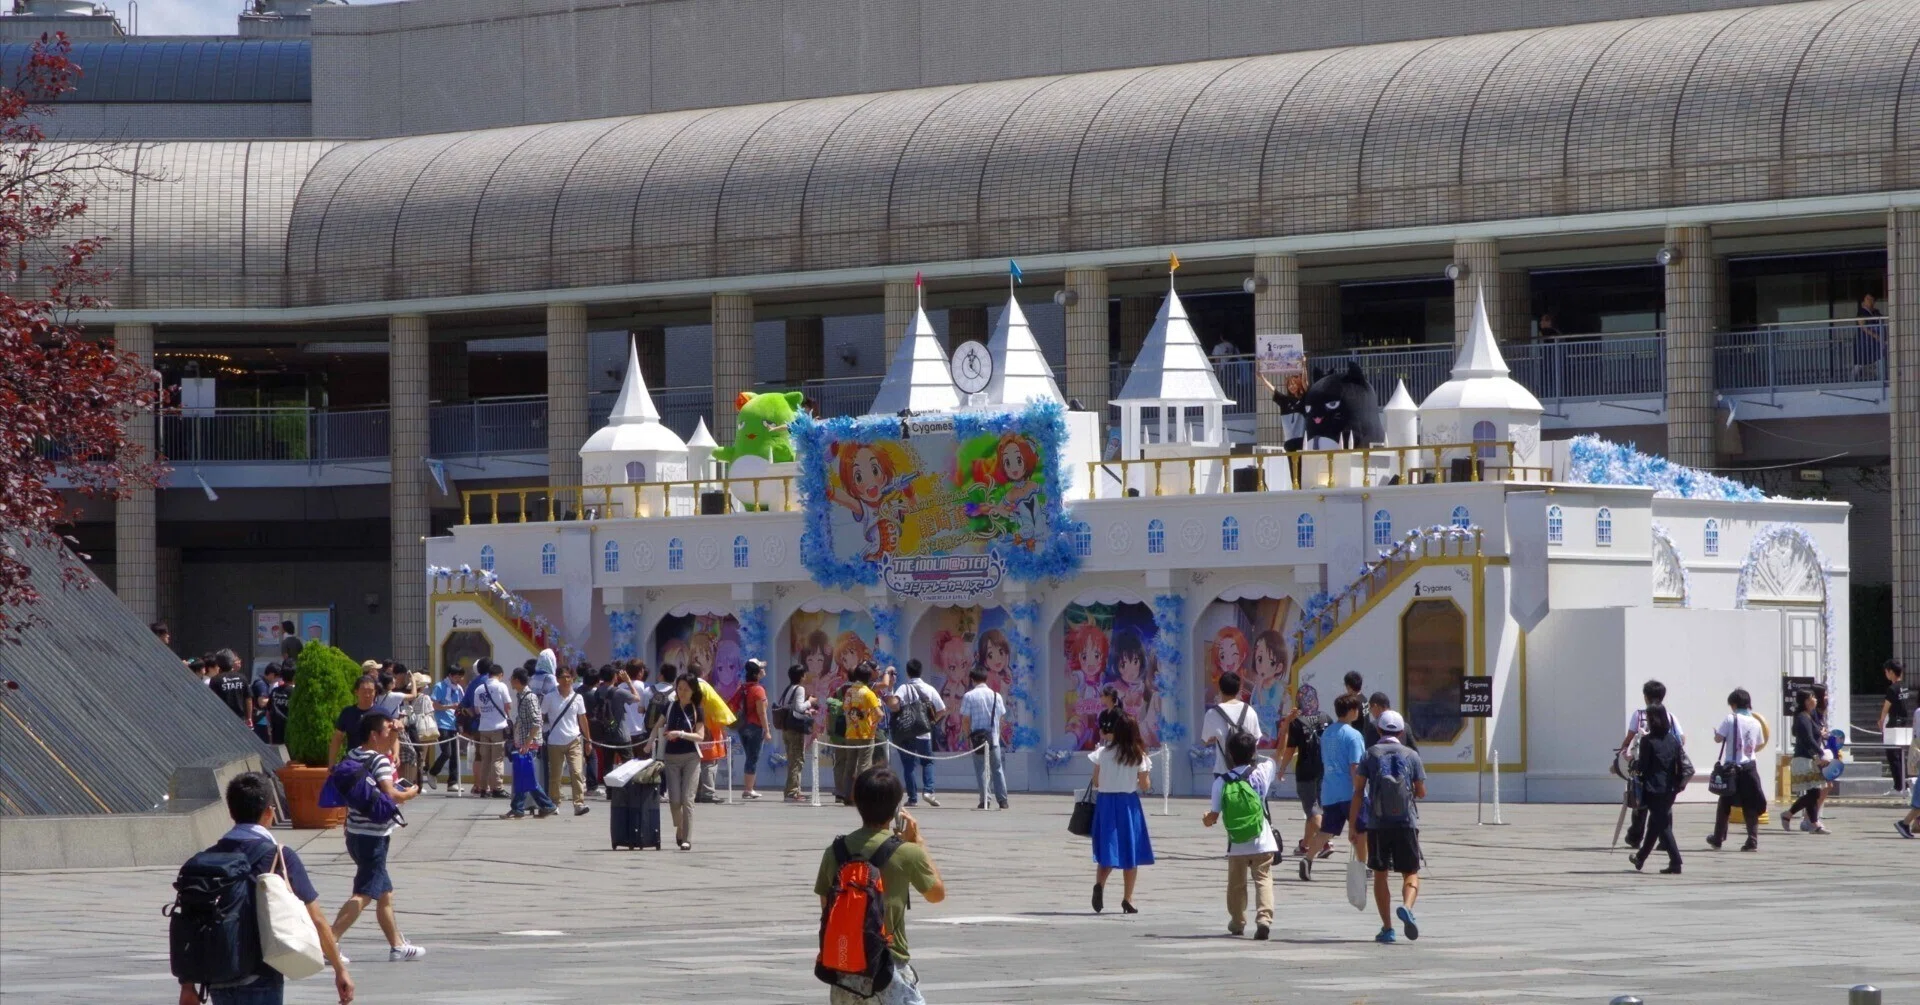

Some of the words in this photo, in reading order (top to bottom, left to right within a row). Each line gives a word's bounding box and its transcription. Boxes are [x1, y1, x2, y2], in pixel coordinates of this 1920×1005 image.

[912, 422, 953, 434] Cygames
[893, 559, 914, 572] THE
[903, 580, 985, 593] シンデレラガールズ
[1422, 585, 1452, 593] Cygames
[222, 682, 244, 691] STAFF
[1464, 694, 1489, 703] フラスタ
